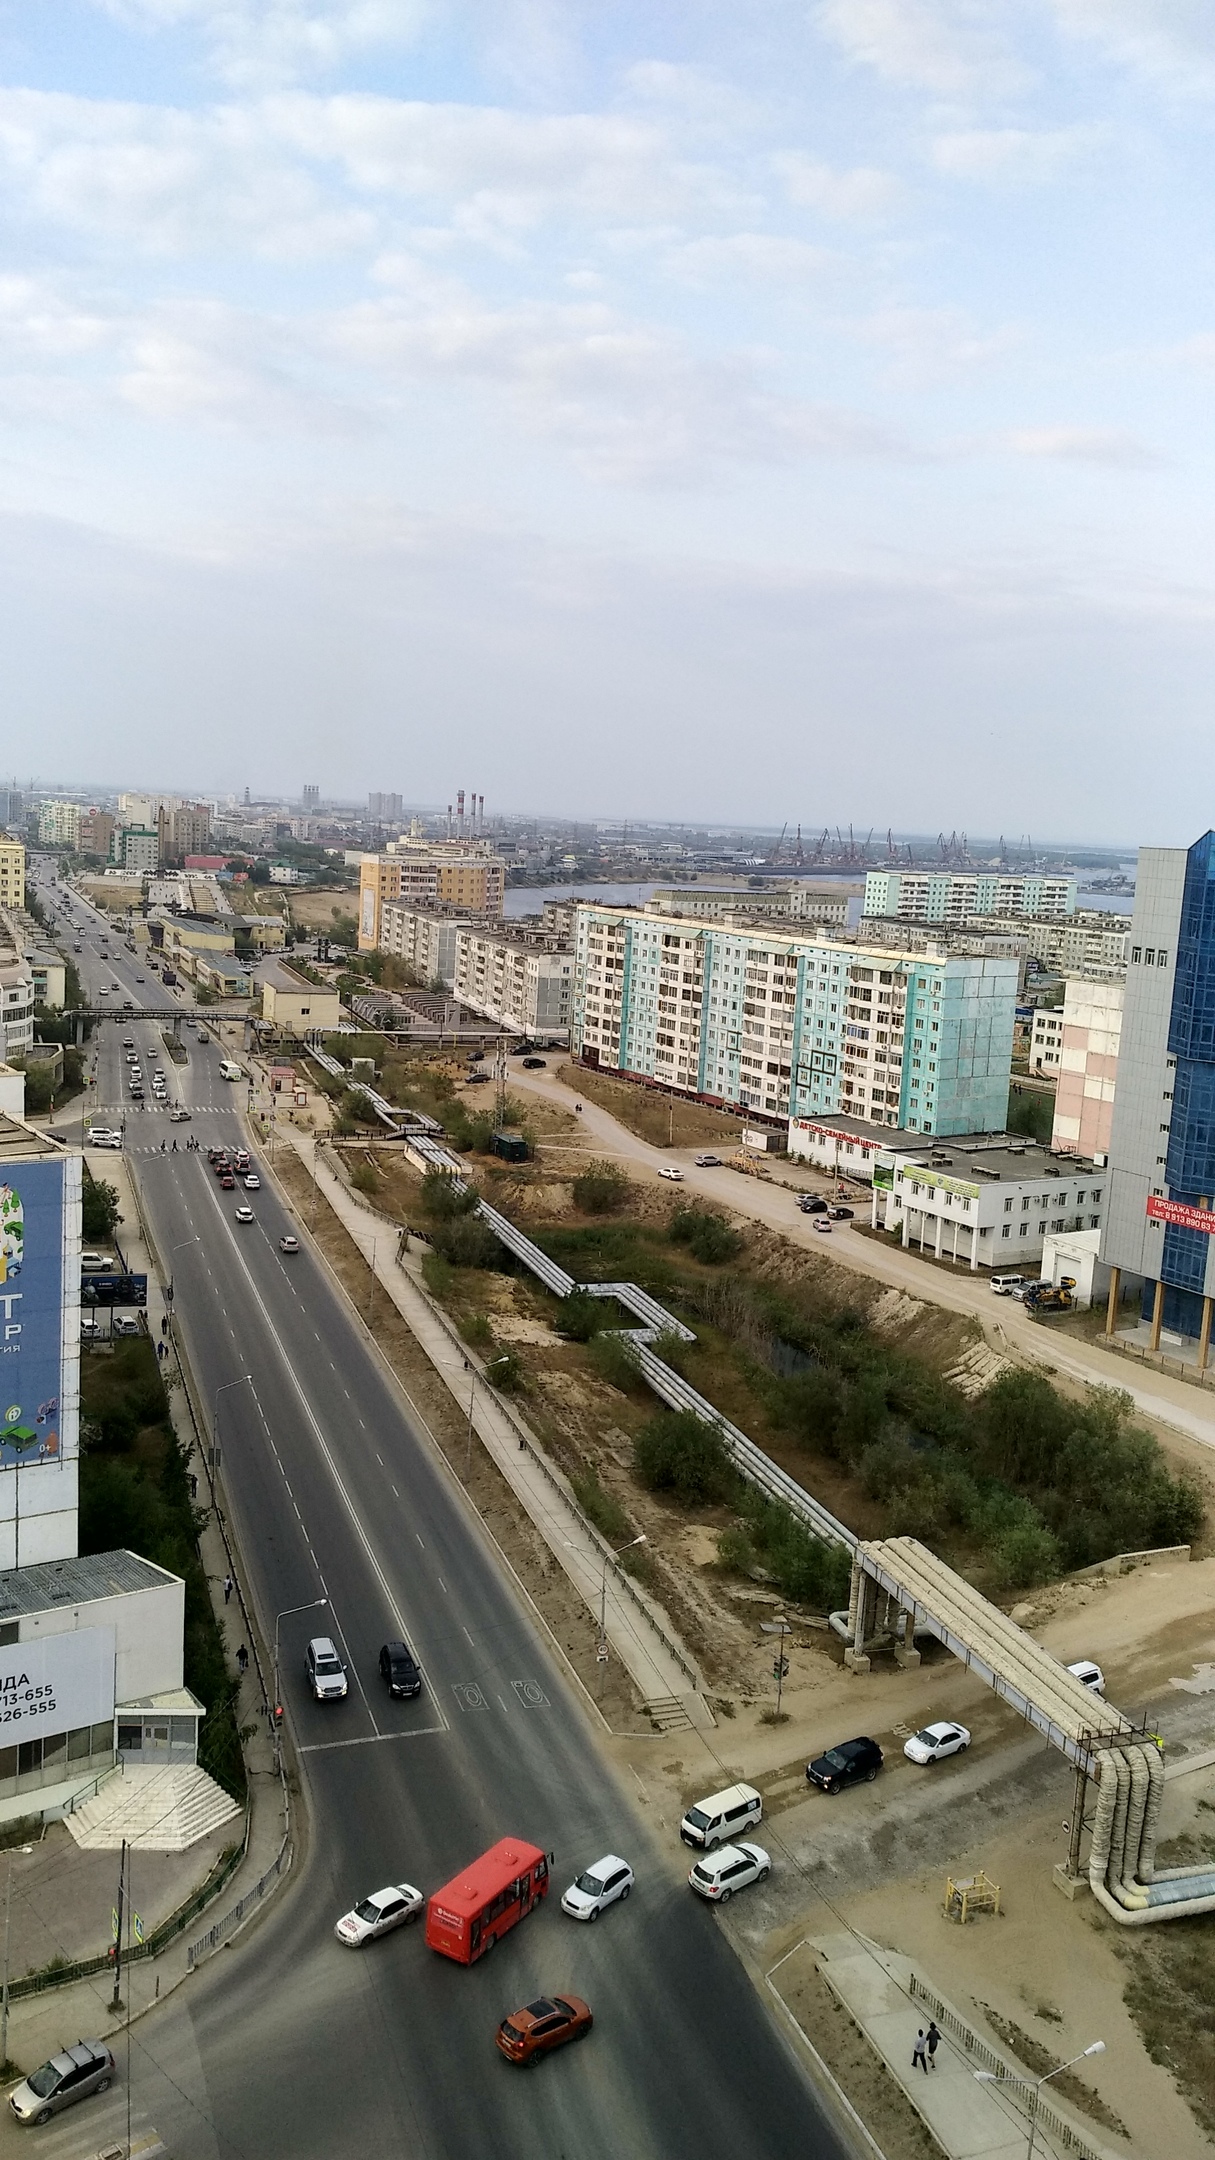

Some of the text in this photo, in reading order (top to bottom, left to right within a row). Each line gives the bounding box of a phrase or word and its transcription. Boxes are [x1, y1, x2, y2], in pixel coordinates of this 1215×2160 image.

[799, 1121, 860, 1145] ДЕТСКО-СЕМЕЙНЫЙ
[1154, 1200, 1190, 1216] ПРОДАЖА
[1171, 1213, 1185, 1224] 913
[1186, 1217, 1201, 1228] 890
[1201, 1222, 1211, 1231] 63
[39, 1443, 51, 1453] 0+
[0, 1673, 30, 1693] ДА
[0, 1684, 53, 1706] 13-655
